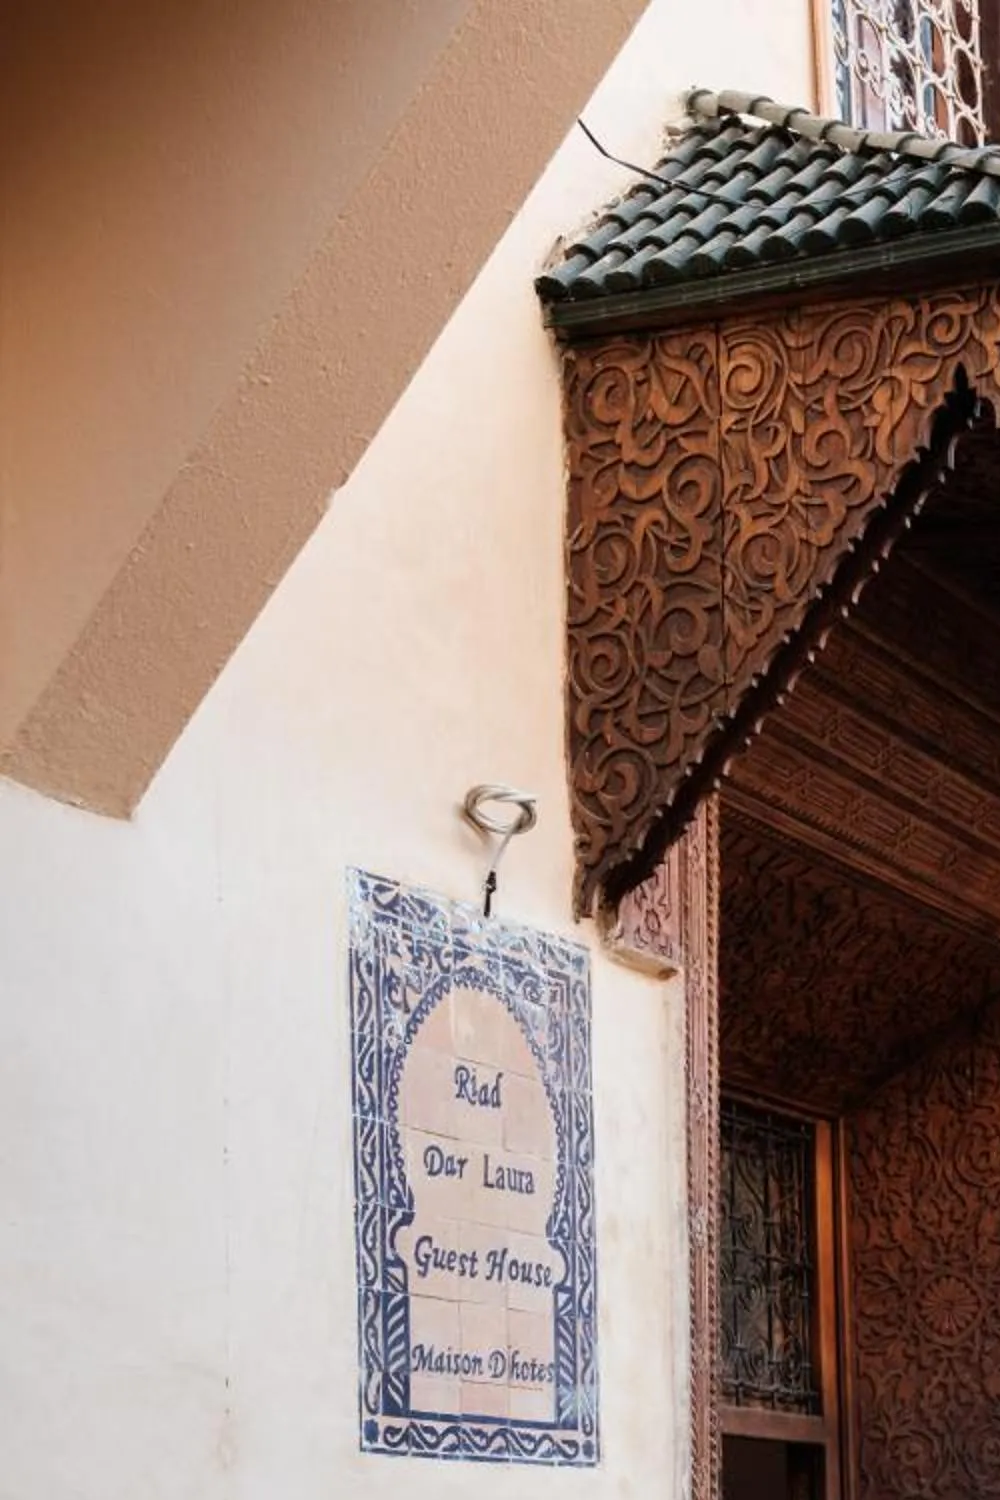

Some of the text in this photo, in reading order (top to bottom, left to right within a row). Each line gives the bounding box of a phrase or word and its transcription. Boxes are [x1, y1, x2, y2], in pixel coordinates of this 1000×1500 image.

[454, 1065, 503, 1108] Riad
[423, 1145, 535, 1194] Dar Laura
[414, 1235, 552, 1287] Guest House
[411, 1343, 483, 1375] Maison
